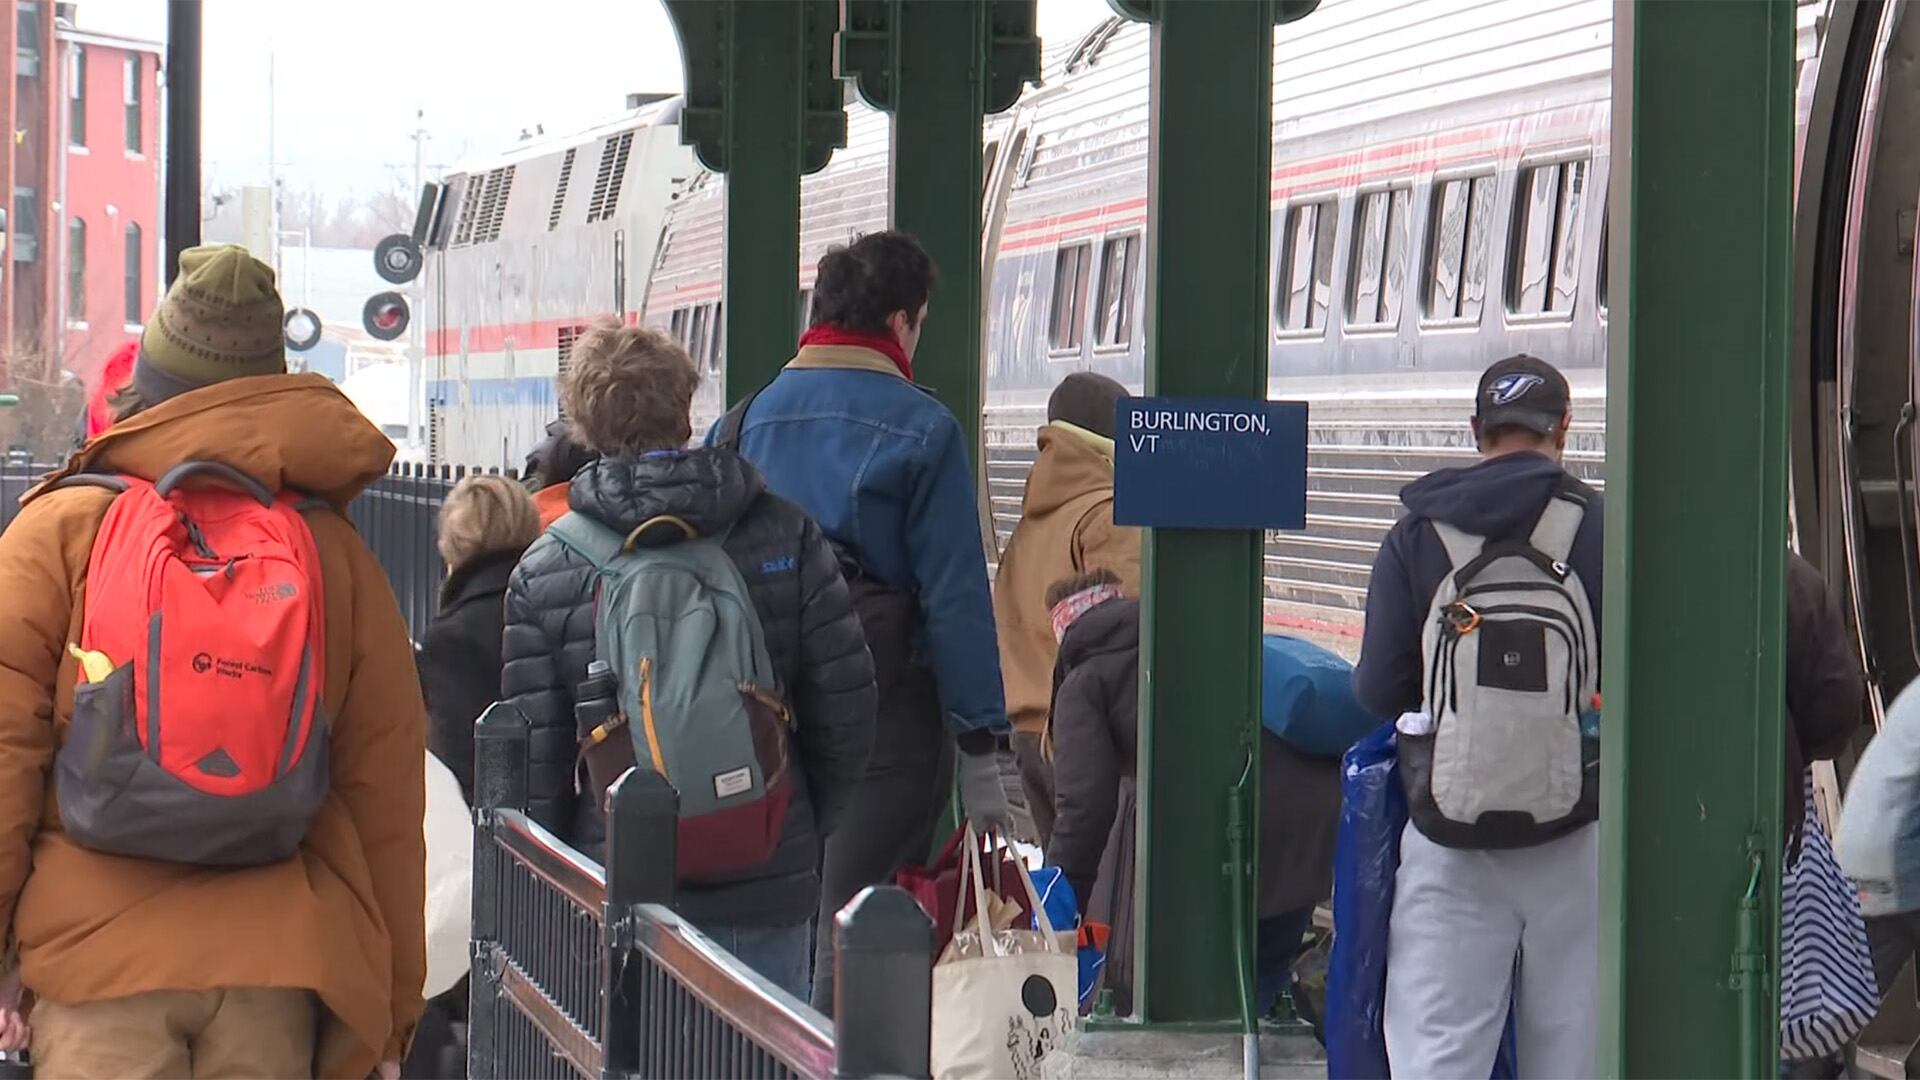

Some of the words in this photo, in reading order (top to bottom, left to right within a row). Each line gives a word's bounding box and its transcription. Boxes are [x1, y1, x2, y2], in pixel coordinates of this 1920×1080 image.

[1130, 410, 1271, 436] BURLINGTON,
[1130, 434, 1160, 453] VT
[216, 658, 243, 670] Forest
